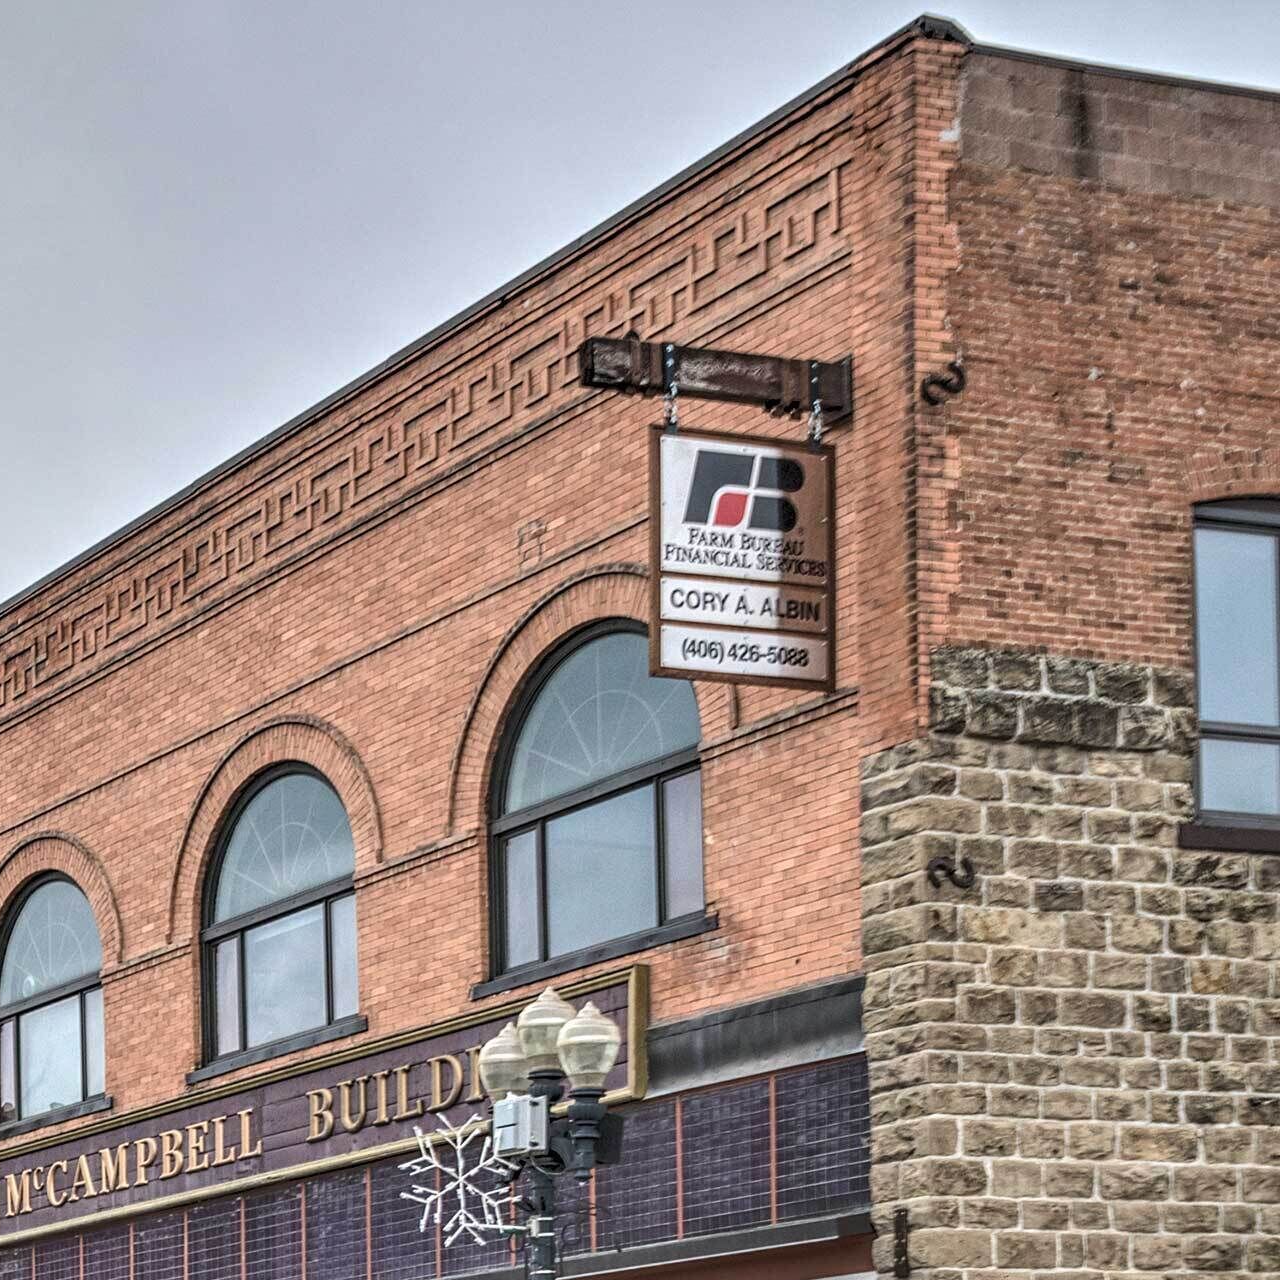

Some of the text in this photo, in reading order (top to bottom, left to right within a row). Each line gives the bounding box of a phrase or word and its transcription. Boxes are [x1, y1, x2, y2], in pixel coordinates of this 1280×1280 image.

[688, 528, 804, 556] FARM BUREAU
[664, 543, 826, 577] FINANCIAL SERVICES
[671, 589, 821, 621] CORY A. ALBIN
[682, 637, 809, 667] (406) 426-5088
[305, 1045, 488, 1143] BUILDI
